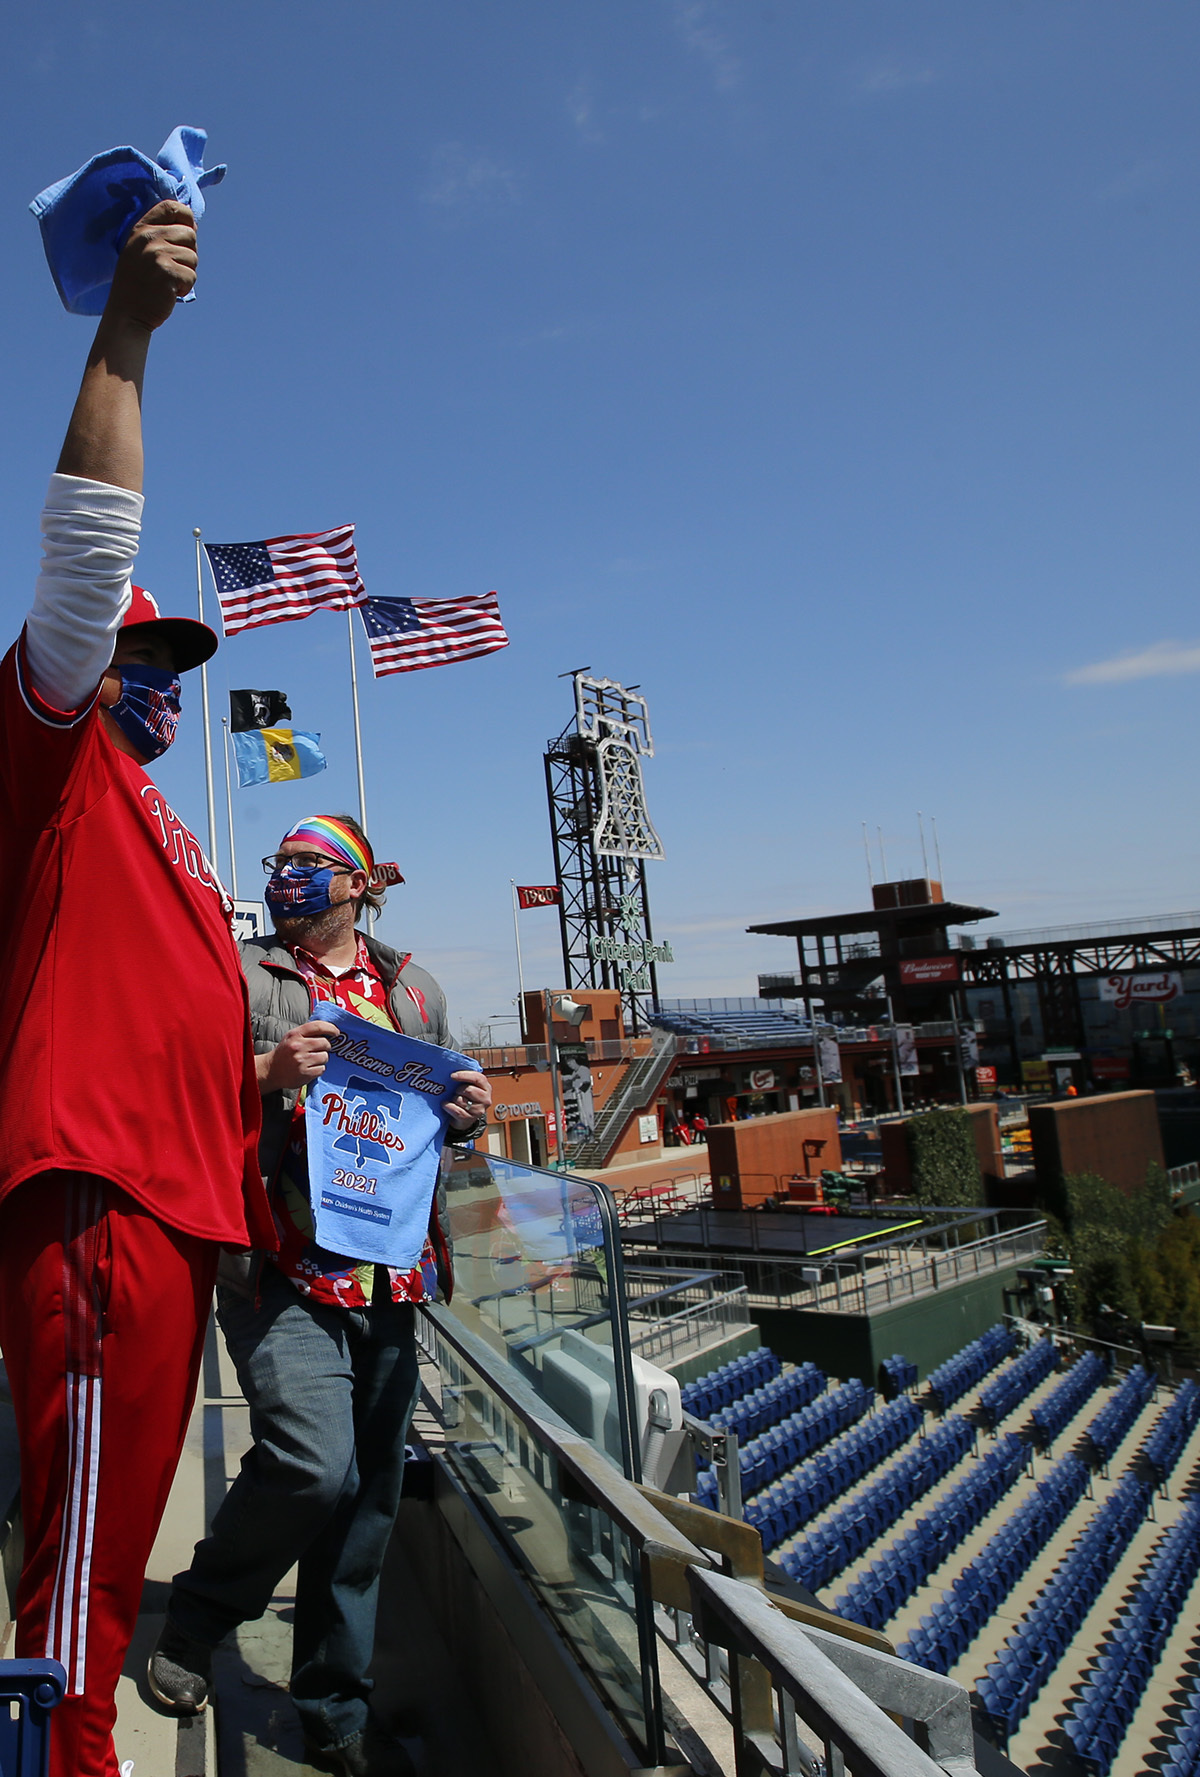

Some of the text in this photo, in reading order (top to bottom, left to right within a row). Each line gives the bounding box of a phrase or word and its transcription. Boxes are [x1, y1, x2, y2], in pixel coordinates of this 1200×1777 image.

[522, 887, 554, 905] 1980
[590, 936, 675, 963] Citizens Bank
[621, 966, 652, 991] Park
[1107, 973, 1178, 1008] Yard
[329, 1032, 446, 1096] Welcome Home
[321, 1092, 404, 1152] Phillies
[508, 1101, 542, 1117] TOYOTA
[332, 1168, 377, 1196] 2021
[358, 1205, 373, 1216] Health
